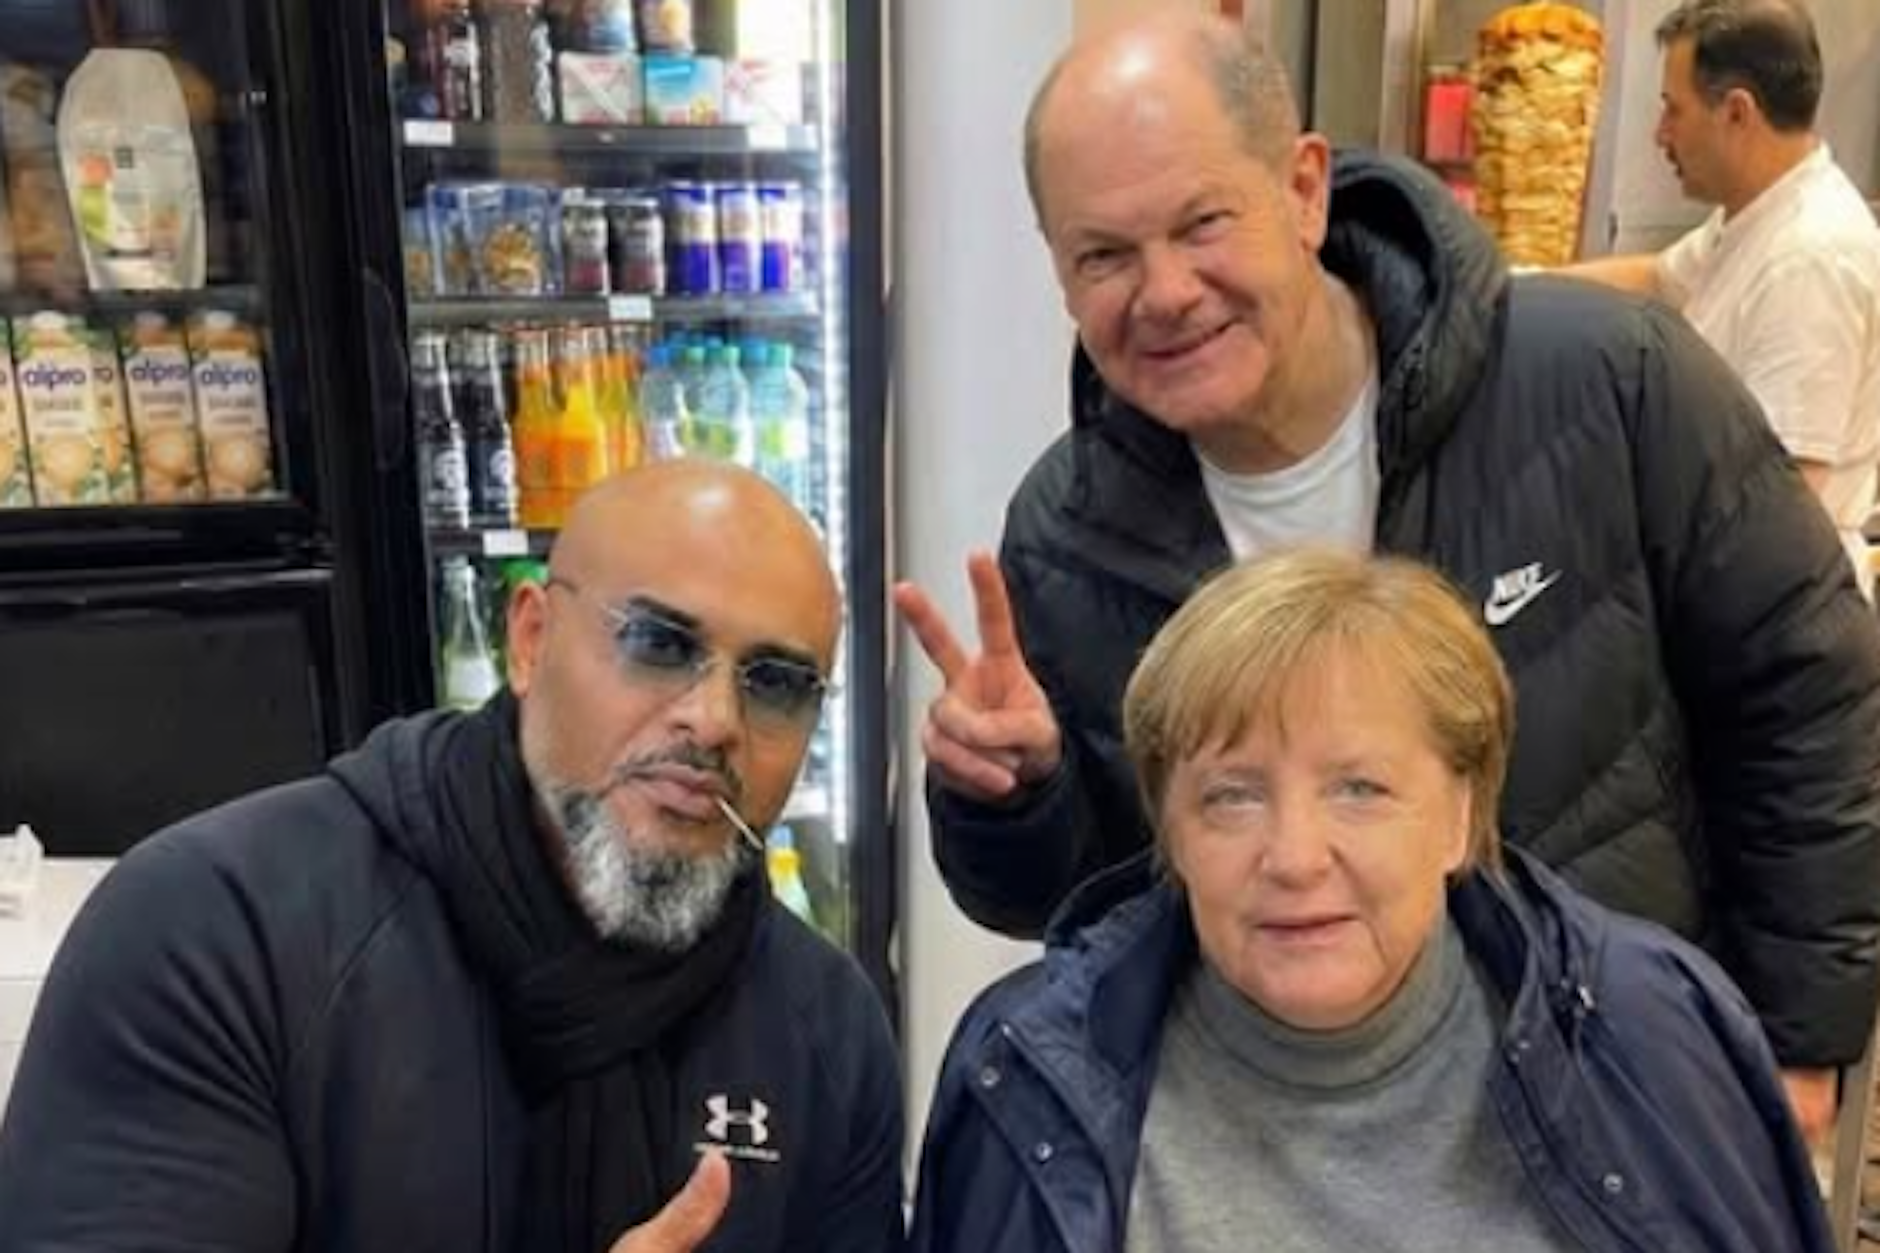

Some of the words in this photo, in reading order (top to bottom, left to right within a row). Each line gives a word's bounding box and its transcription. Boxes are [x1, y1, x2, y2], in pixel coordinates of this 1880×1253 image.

[24, 363, 86, 391] alpro
[131, 359, 189, 387] alpro
[201, 362, 256, 391] alpro
